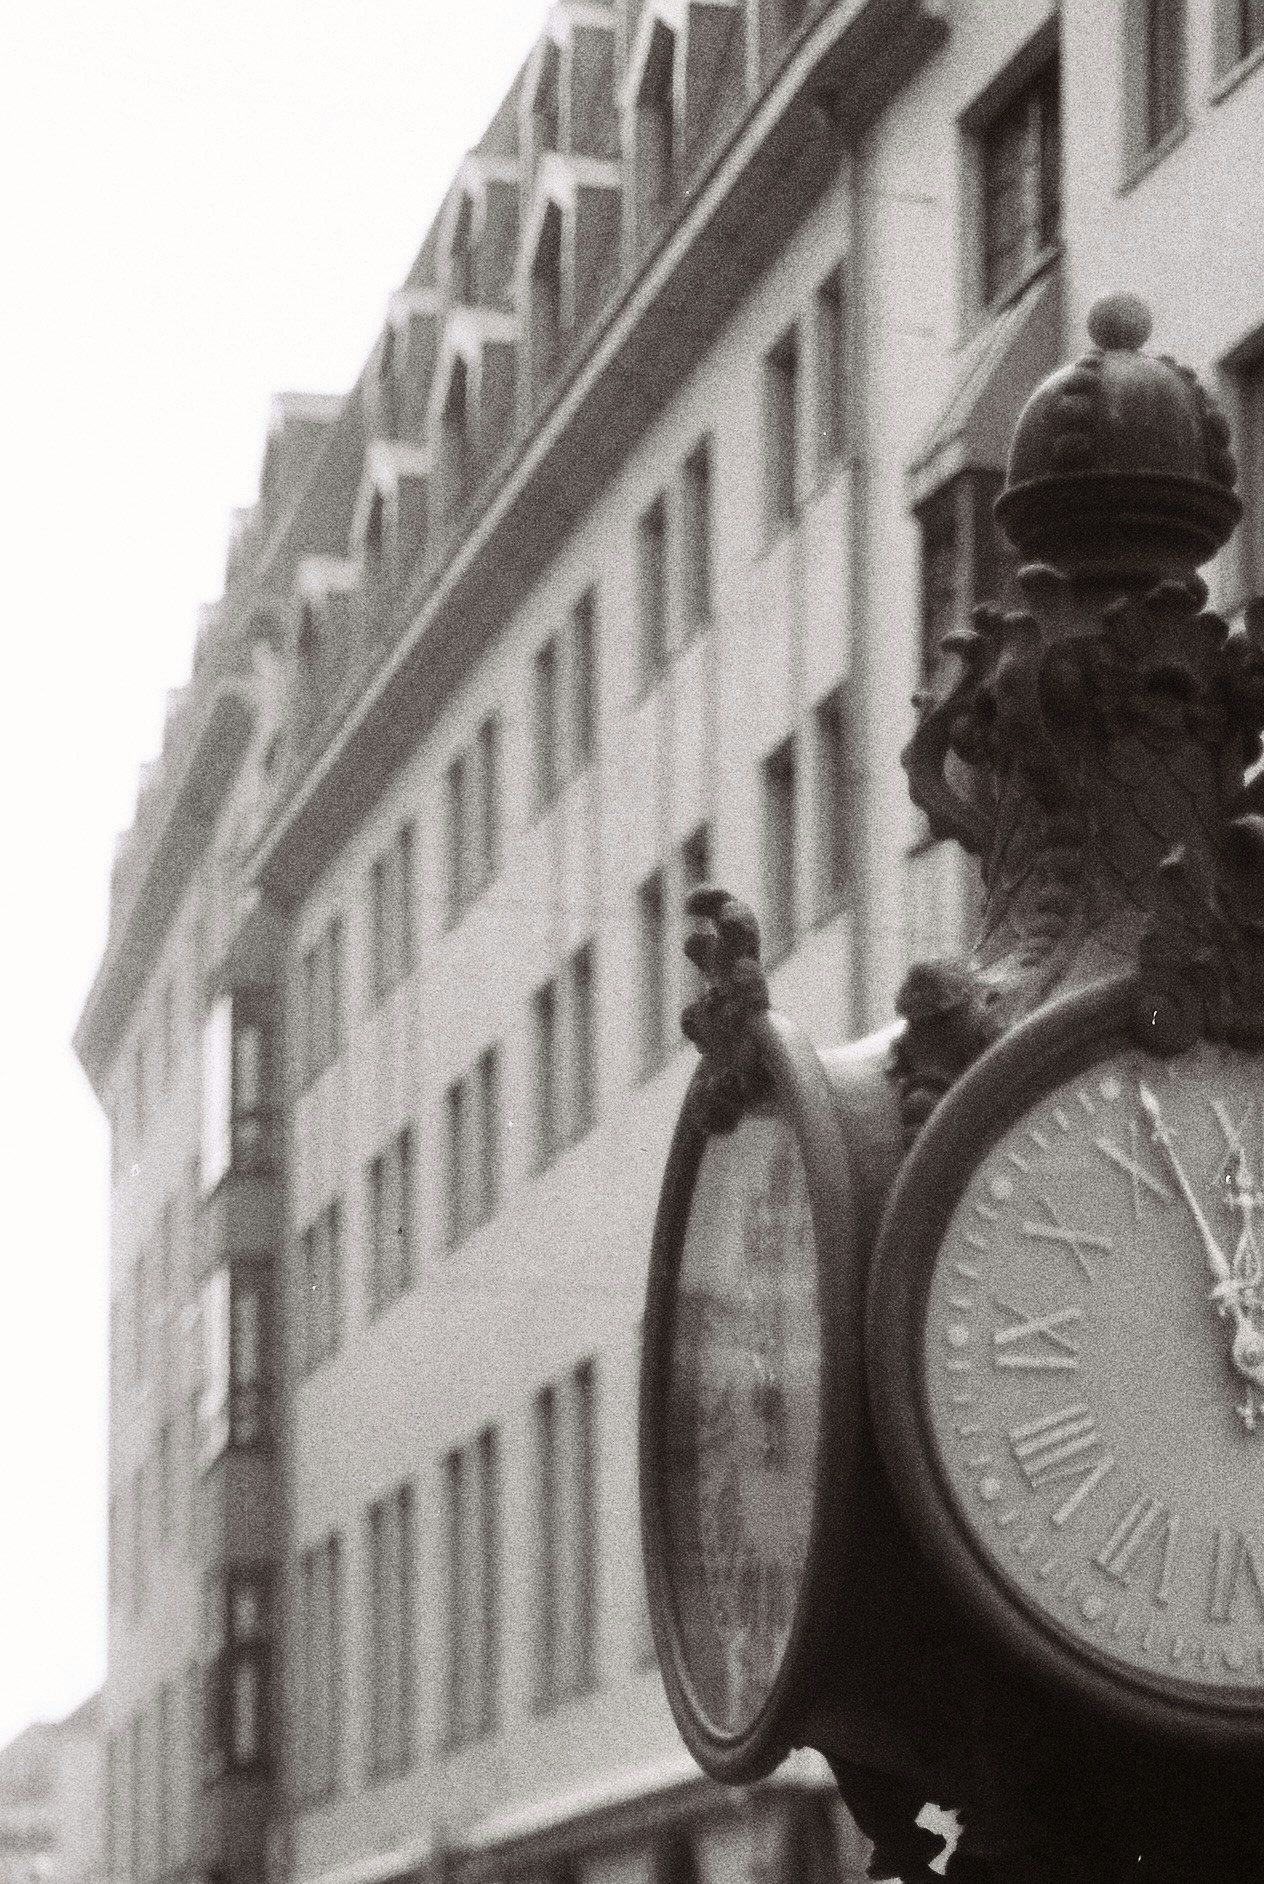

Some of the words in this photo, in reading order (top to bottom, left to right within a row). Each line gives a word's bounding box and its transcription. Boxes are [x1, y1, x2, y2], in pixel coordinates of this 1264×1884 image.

[1098, 1110, 1192, 1222] X
[1022, 1195, 1114, 1283] X
[994, 1298, 1083, 1374] IX
[1008, 1402, 1115, 1527] VIII
[1093, 1498, 1182, 1611] VII
